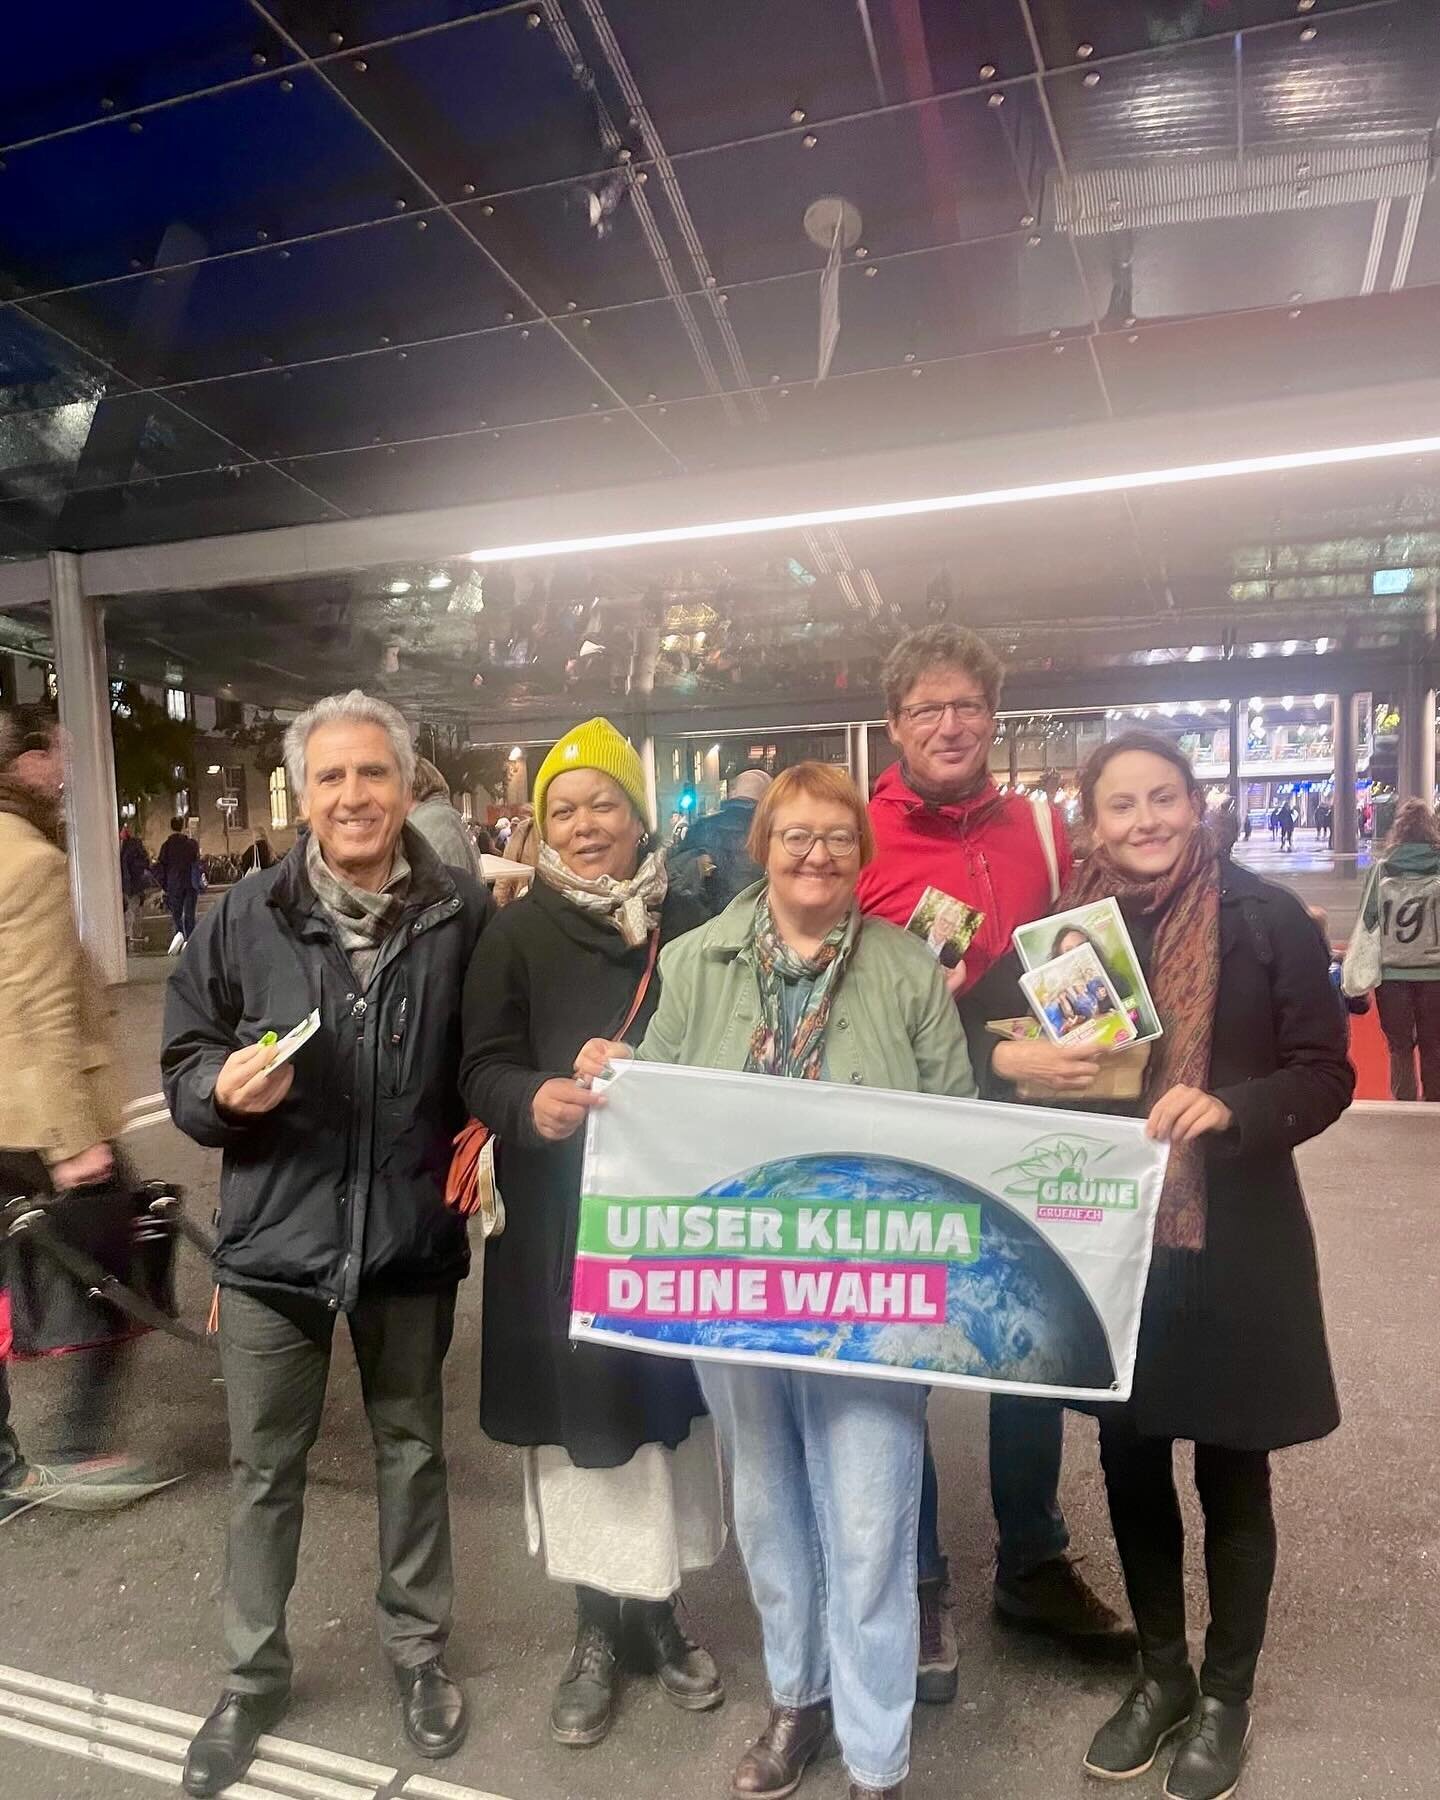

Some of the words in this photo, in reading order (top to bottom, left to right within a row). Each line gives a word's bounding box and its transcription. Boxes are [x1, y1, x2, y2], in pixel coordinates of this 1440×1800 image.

[1041, 1177, 1134, 1205] GRÜNE
[606, 1206, 783, 1250] UNSER
[796, 1207, 972, 1255] KLIMA
[1039, 1207, 1101, 1220] GRUENE.CH
[608, 1269, 768, 1314] DEINE
[781, 1270, 937, 1318] WAHL
